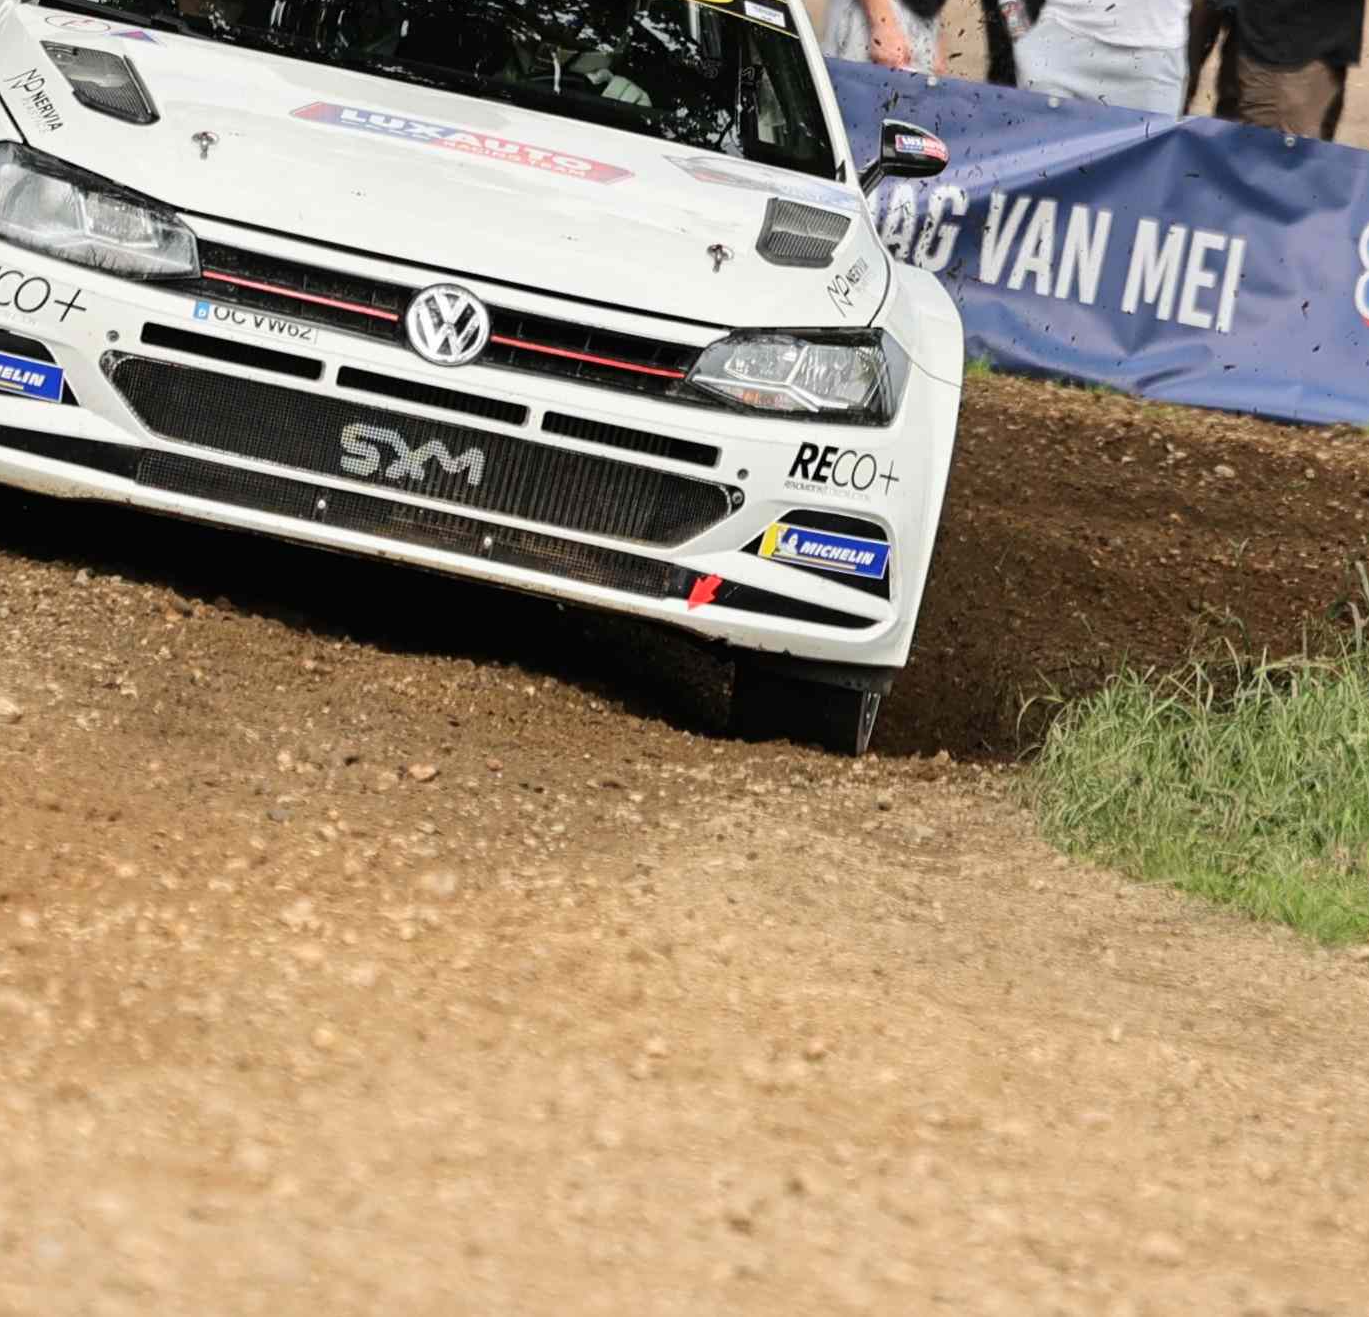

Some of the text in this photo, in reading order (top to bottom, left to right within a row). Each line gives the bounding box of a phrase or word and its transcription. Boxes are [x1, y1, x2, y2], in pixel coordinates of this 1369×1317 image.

[31, 91, 64, 131] NERVIA
[340, 109, 593, 172] LUXAUTO
[441, 139, 523, 162] RACING
[866, 184, 1248, 334] AG VAN MEI
[340, 423, 485, 486] SXM
[788, 441, 900, 496] RECO+
[799, 541, 875, 566] MICHELIN
